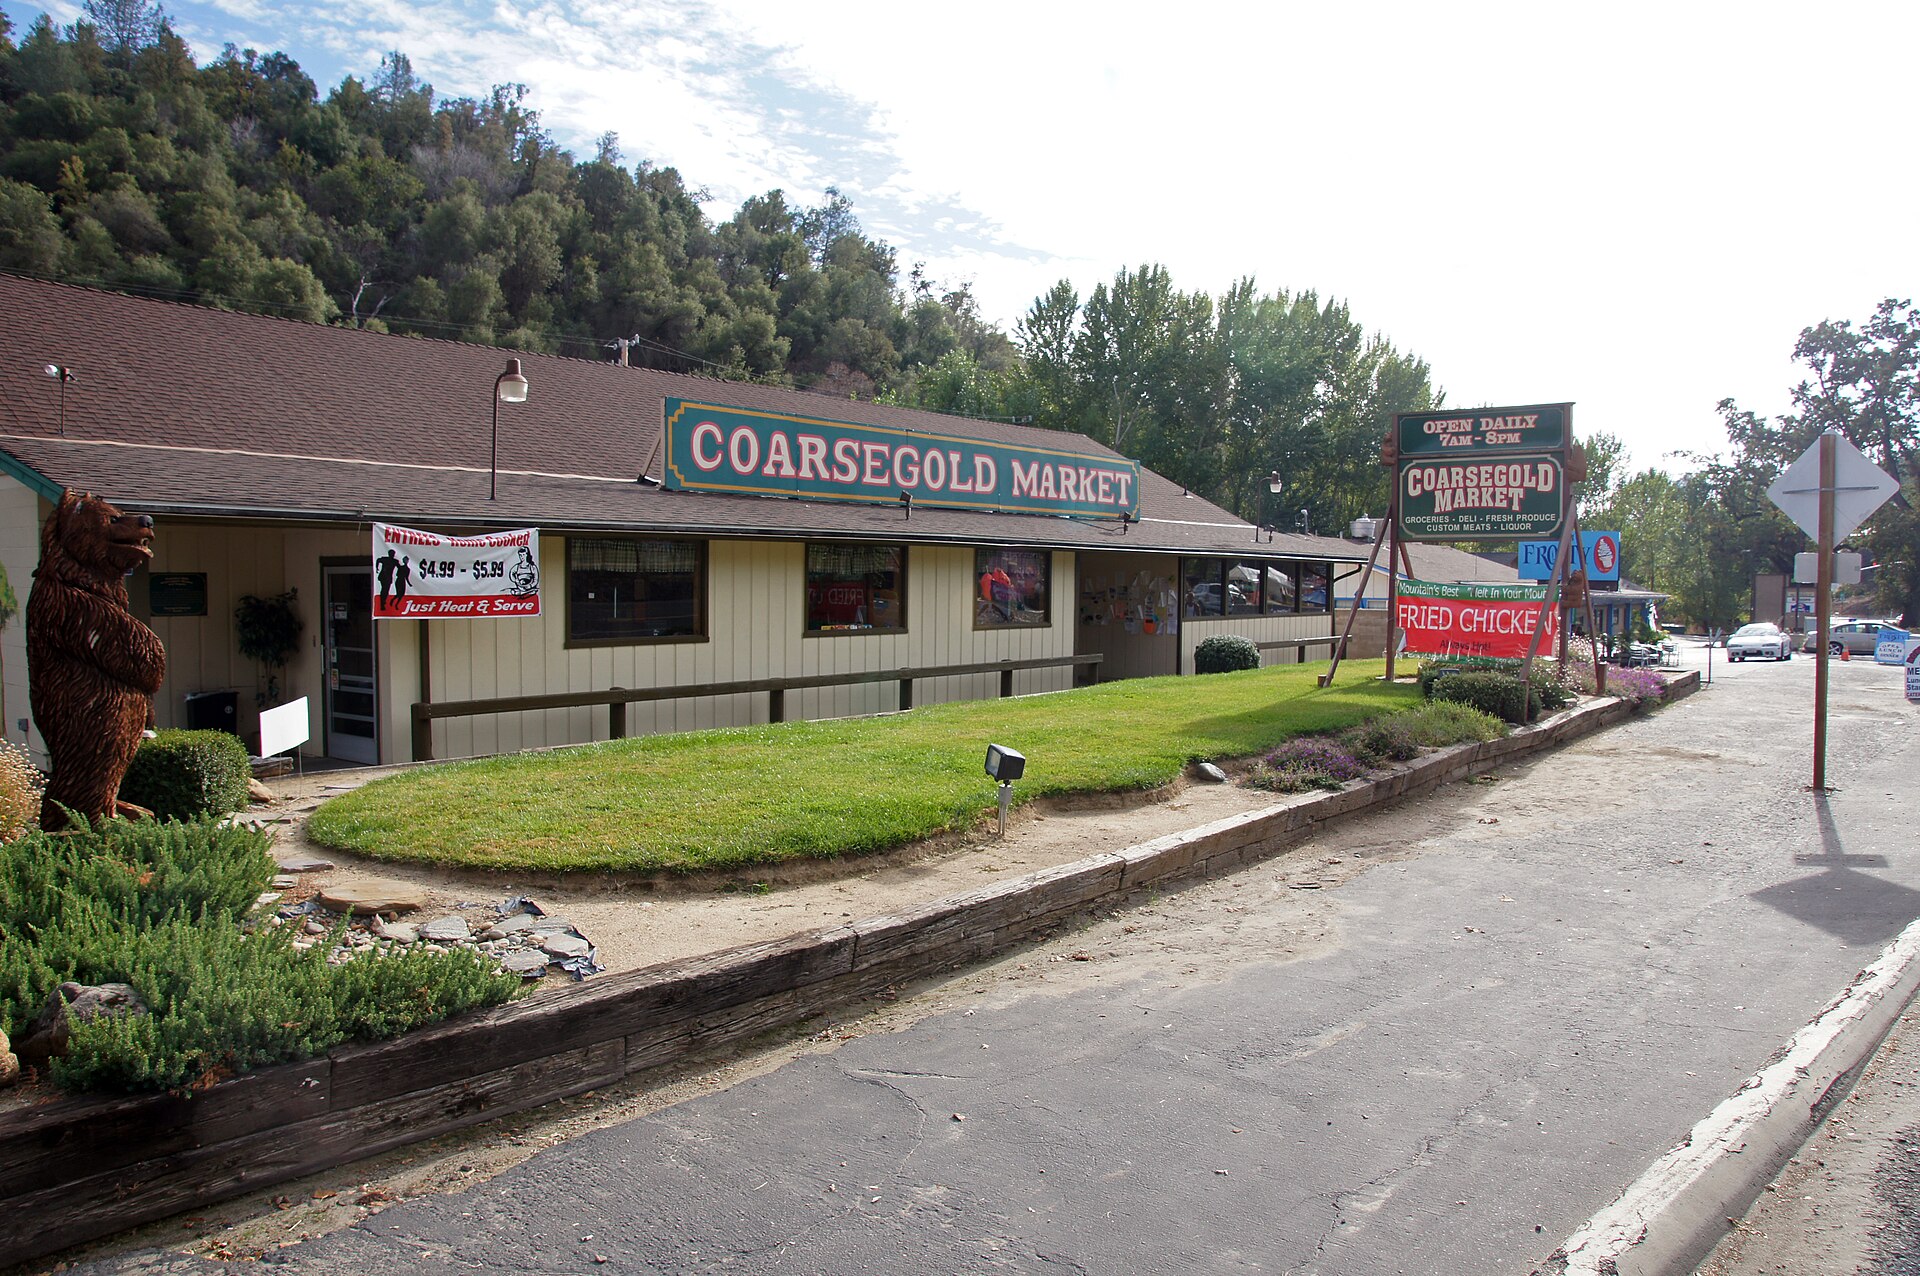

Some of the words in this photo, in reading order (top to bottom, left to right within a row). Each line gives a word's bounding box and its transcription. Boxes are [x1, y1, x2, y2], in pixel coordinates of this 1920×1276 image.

[1423, 418, 1473, 434] OPEN
[1479, 414, 1538, 431] DAILY
[1439, 433, 1473, 447] 7AM
[1485, 431, 1521, 445] 8PM
[691, 421, 997, 493] COARSEGOLD
[1011, 459, 1132, 506] MARKET
[1407, 462, 1555, 497] COARSEGOLD
[1434, 487, 1524, 513] MARKET
[1405, 515, 1450, 524] GROCERIES
[1458, 515, 1477, 523] DELI
[1485, 514, 1513, 522] FRESH
[1516, 513, 1556, 521] PRODUCE
[1426, 524, 1460, 532] CUSTOM
[1462, 523, 1491, 531] MEATS
[1500, 522, 1532, 531] LIQUOR
[1523, 544, 1592, 571] FROTY
[419, 558, 455, 580] $4.99
[473, 559, 504, 580] $5.99
[1399, 581, 1439, 596] Mountain's
[1441, 585, 1459, 597] Best
[1490, 588, 1500, 599] In
[1502, 588, 1523, 599] Your
[1525, 588, 1548, 599] Mout
[402, 599, 434, 615] Just
[438, 600, 474, 612] Heat
[476, 599, 490, 614] &
[493, 599, 534, 611] Serve
[1398, 604, 1453, 631] FRIED
[1459, 608, 1553, 635] CHICKEN
[1907, 667, 1920, 675] ME
